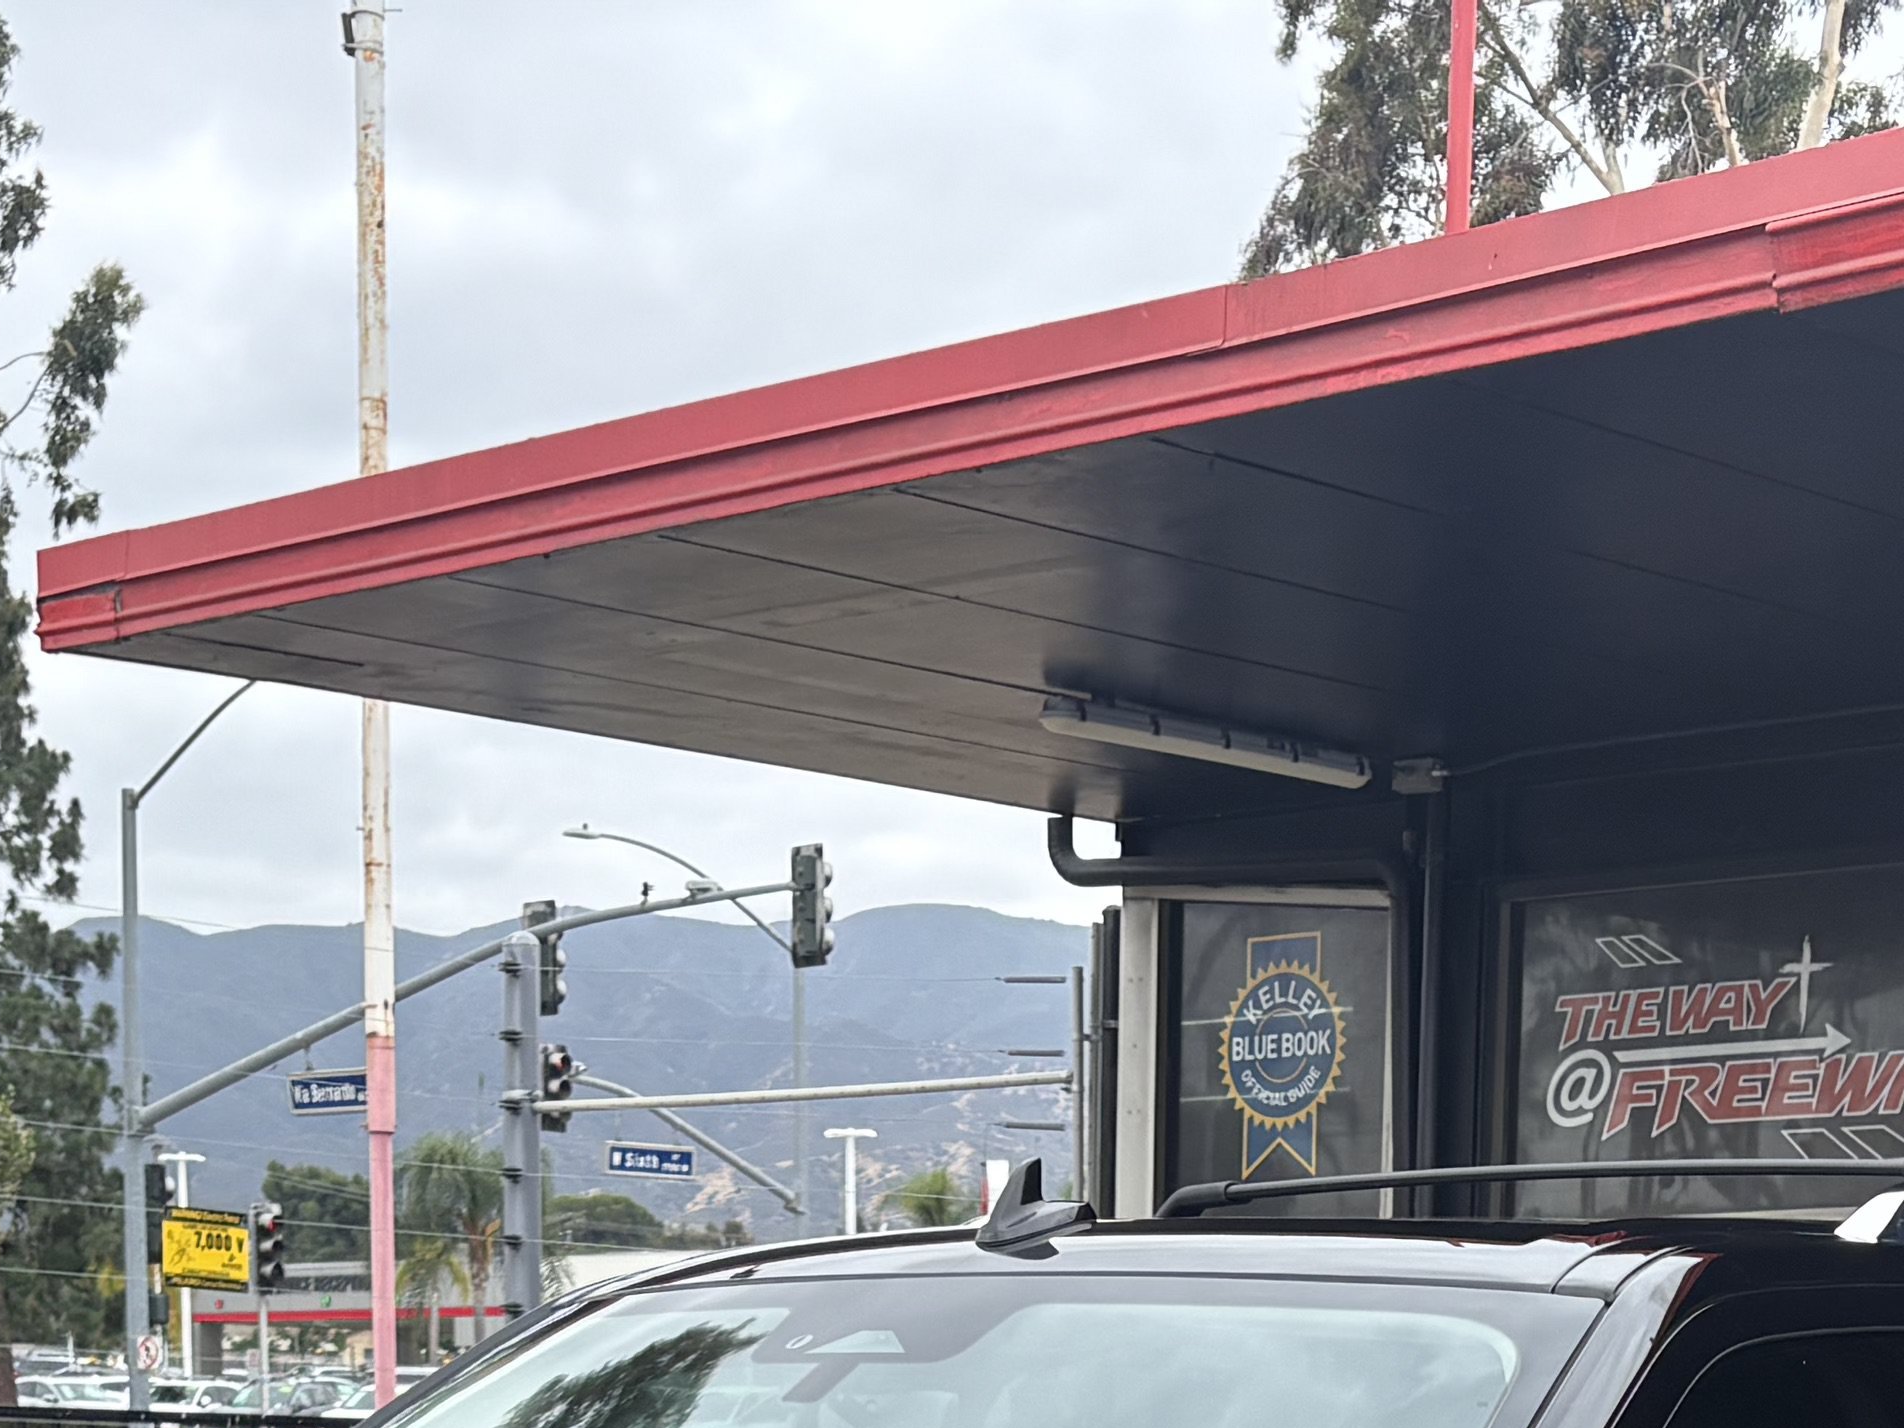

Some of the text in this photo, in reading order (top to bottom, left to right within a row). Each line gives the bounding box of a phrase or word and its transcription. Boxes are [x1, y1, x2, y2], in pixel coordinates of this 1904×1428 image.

[1243, 980, 1327, 1025] KELLEY
[1555, 977, 1797, 1051] THE WAY
[1232, 1028, 1331, 1062] BLUE BOOK
[1287, 1066, 1321, 1103] GUIDE
[194, 1230, 245, 1253] 7,000 V
